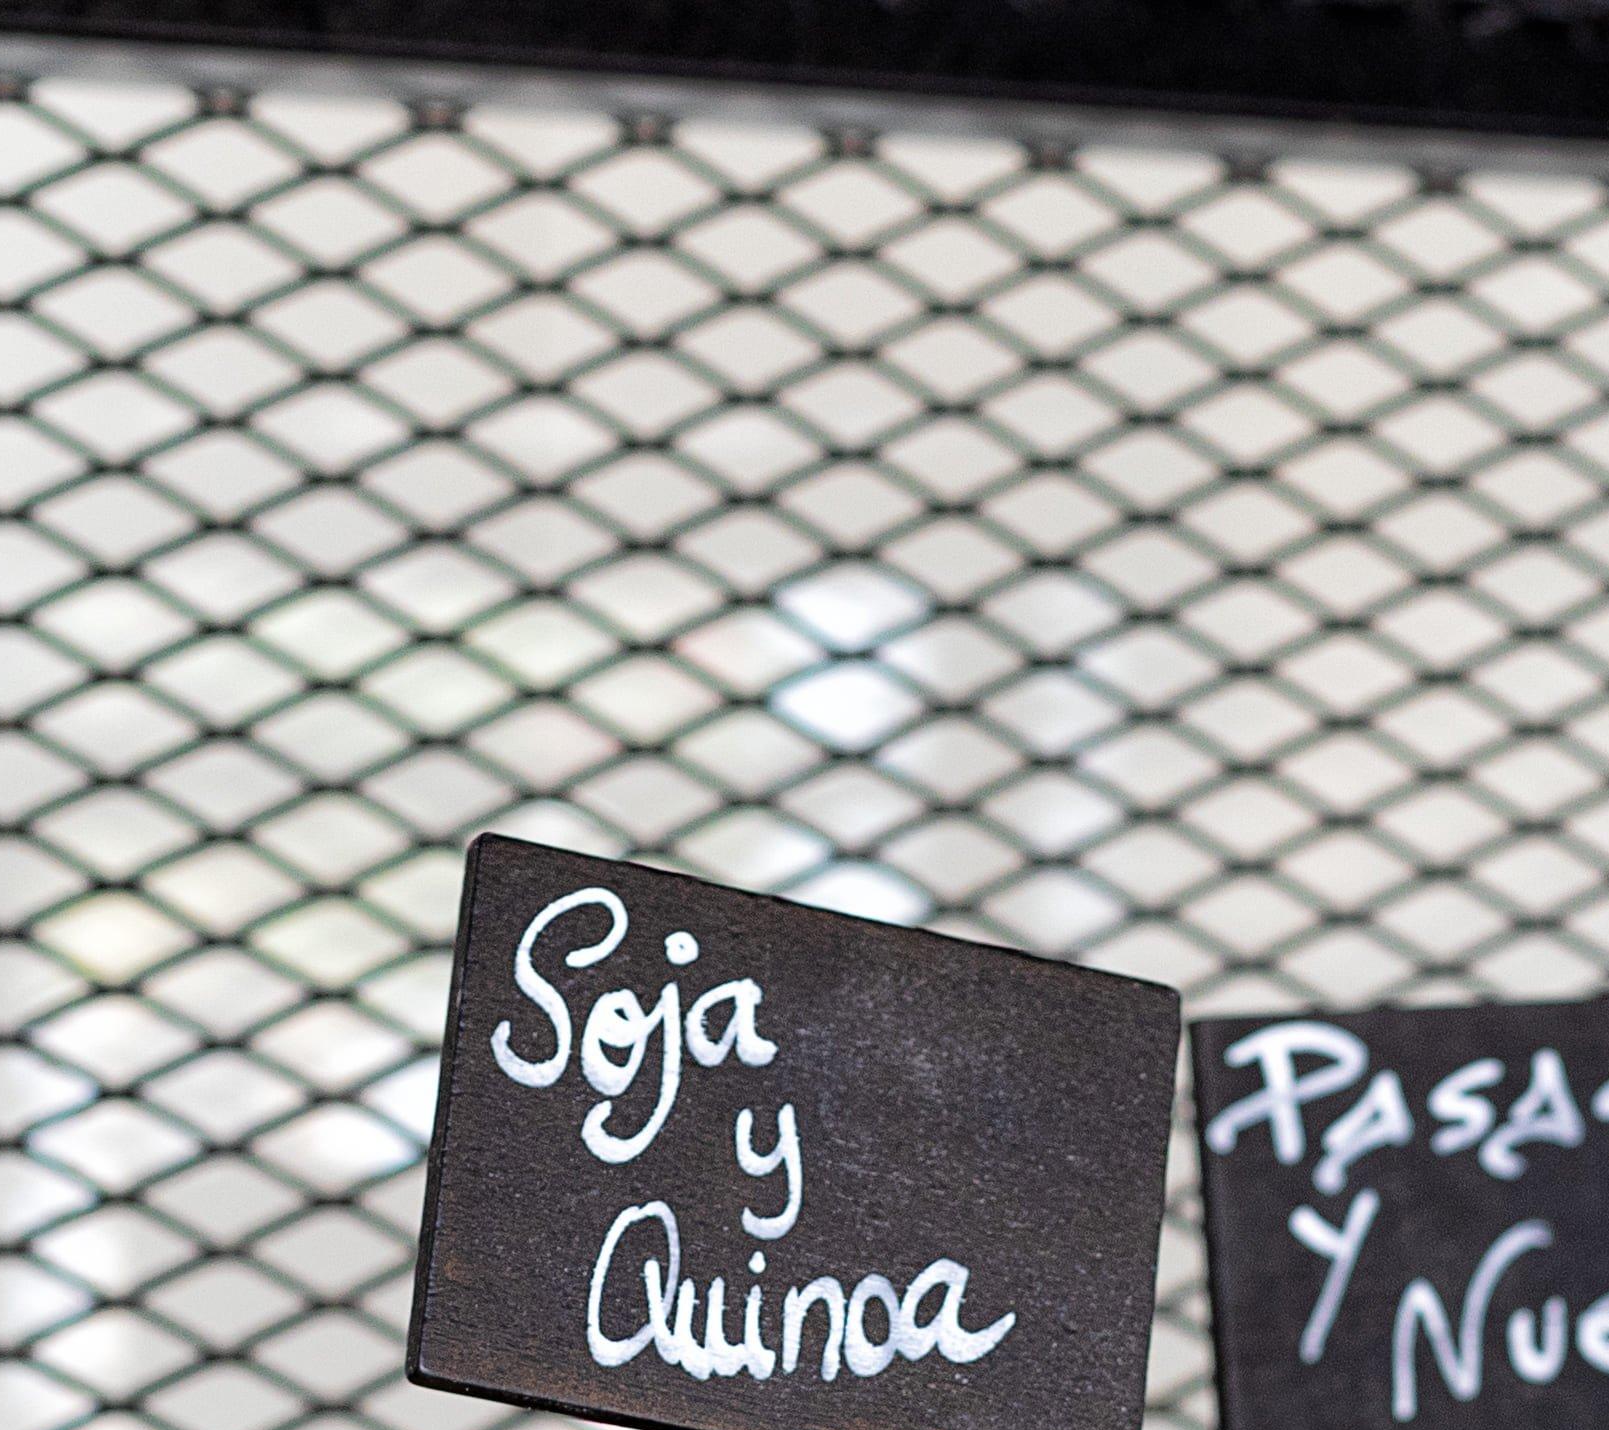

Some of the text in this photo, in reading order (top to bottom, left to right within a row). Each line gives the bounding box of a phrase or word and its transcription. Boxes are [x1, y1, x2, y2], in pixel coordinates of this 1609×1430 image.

[492, 887, 778, 1163] Soja
[735, 1103, 802, 1240] y
[587, 1200, 1015, 1381] Quinoa
